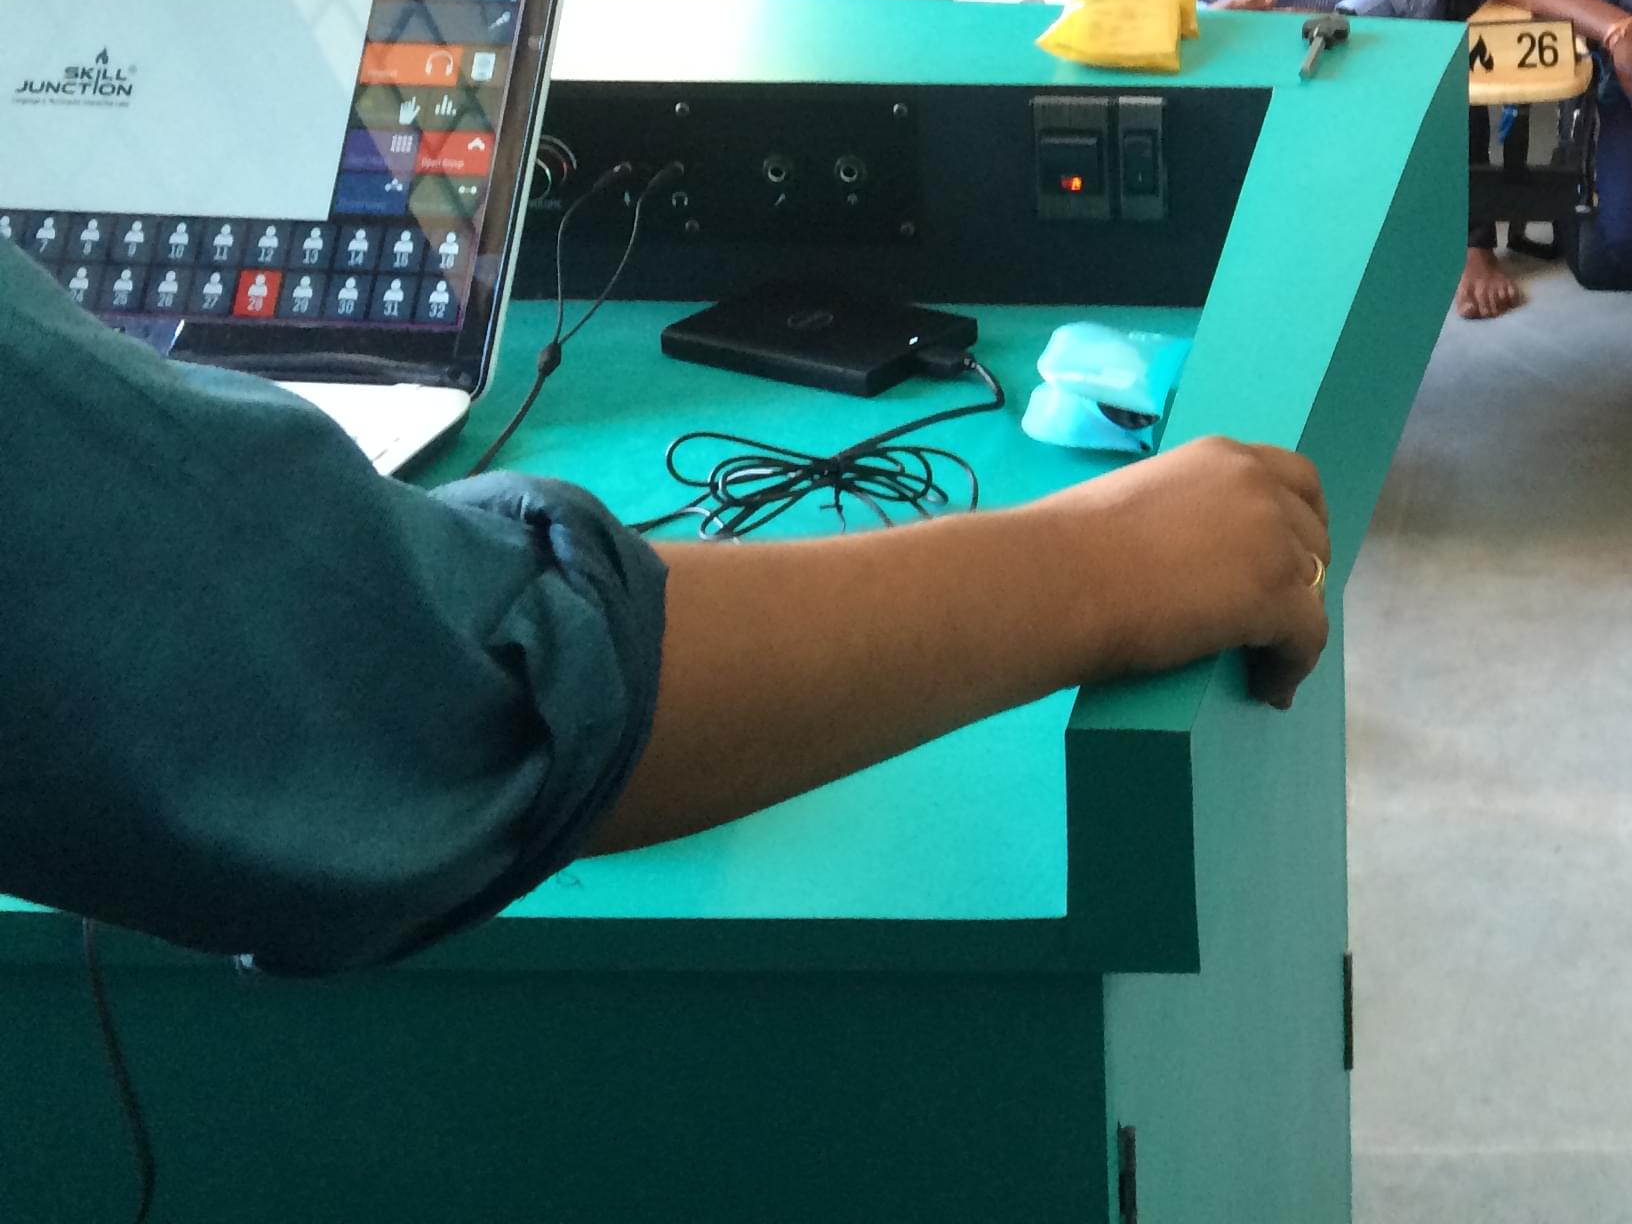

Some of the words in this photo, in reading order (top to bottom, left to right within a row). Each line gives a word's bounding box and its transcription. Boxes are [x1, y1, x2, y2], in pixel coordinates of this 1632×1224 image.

[1517, 31, 1559, 69] 26
[64, 65, 127, 82] SKILL
[15, 79, 133, 97] JUNCTION
[213, 245, 229, 261] 11
[257, 247, 275, 263] 12
[302, 248, 319, 265] 13
[348, 250, 365, 266] 14
[202, 293, 219, 310] 27
[337, 299, 354, 315] 30
[383, 301, 399, 317] 31
[428, 302, 446, 319] 32
